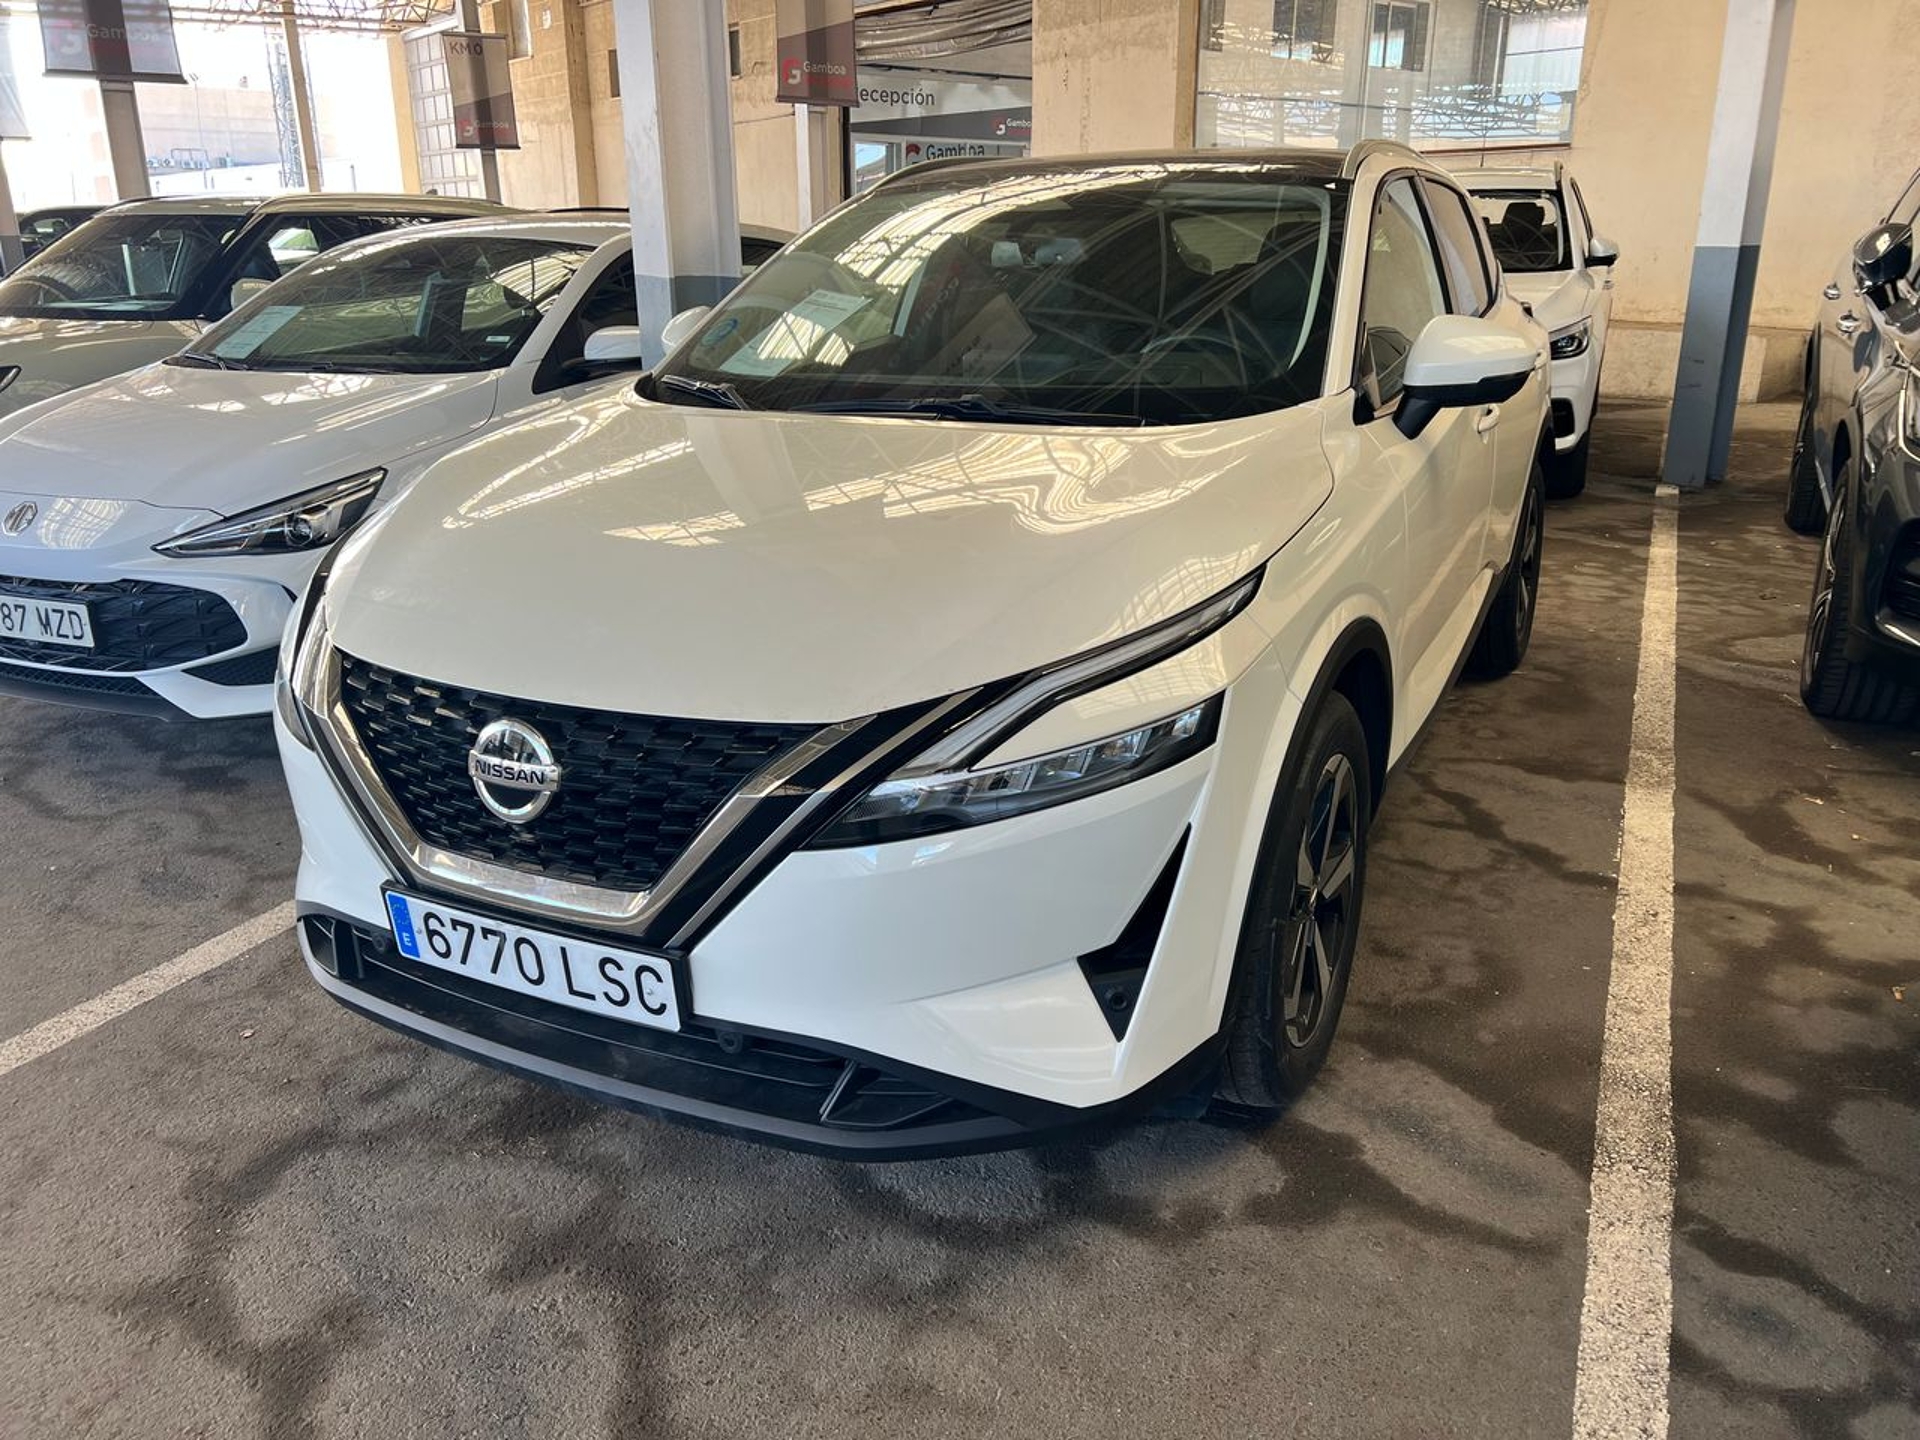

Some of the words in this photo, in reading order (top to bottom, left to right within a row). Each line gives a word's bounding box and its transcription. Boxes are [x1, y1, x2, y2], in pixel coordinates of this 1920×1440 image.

[803, 61, 847, 76] Gamboa
[858, 87, 935, 107] ecepción
[1005, 117, 1032, 129] Gambo
[0, 603, 27, 633] 87
[36, 606, 85, 640] MZD
[474, 759, 545, 786] NISSAN
[402, 932, 412, 947] E
[422, 911, 546, 987] 6770
[559, 945, 668, 1017] LSC
